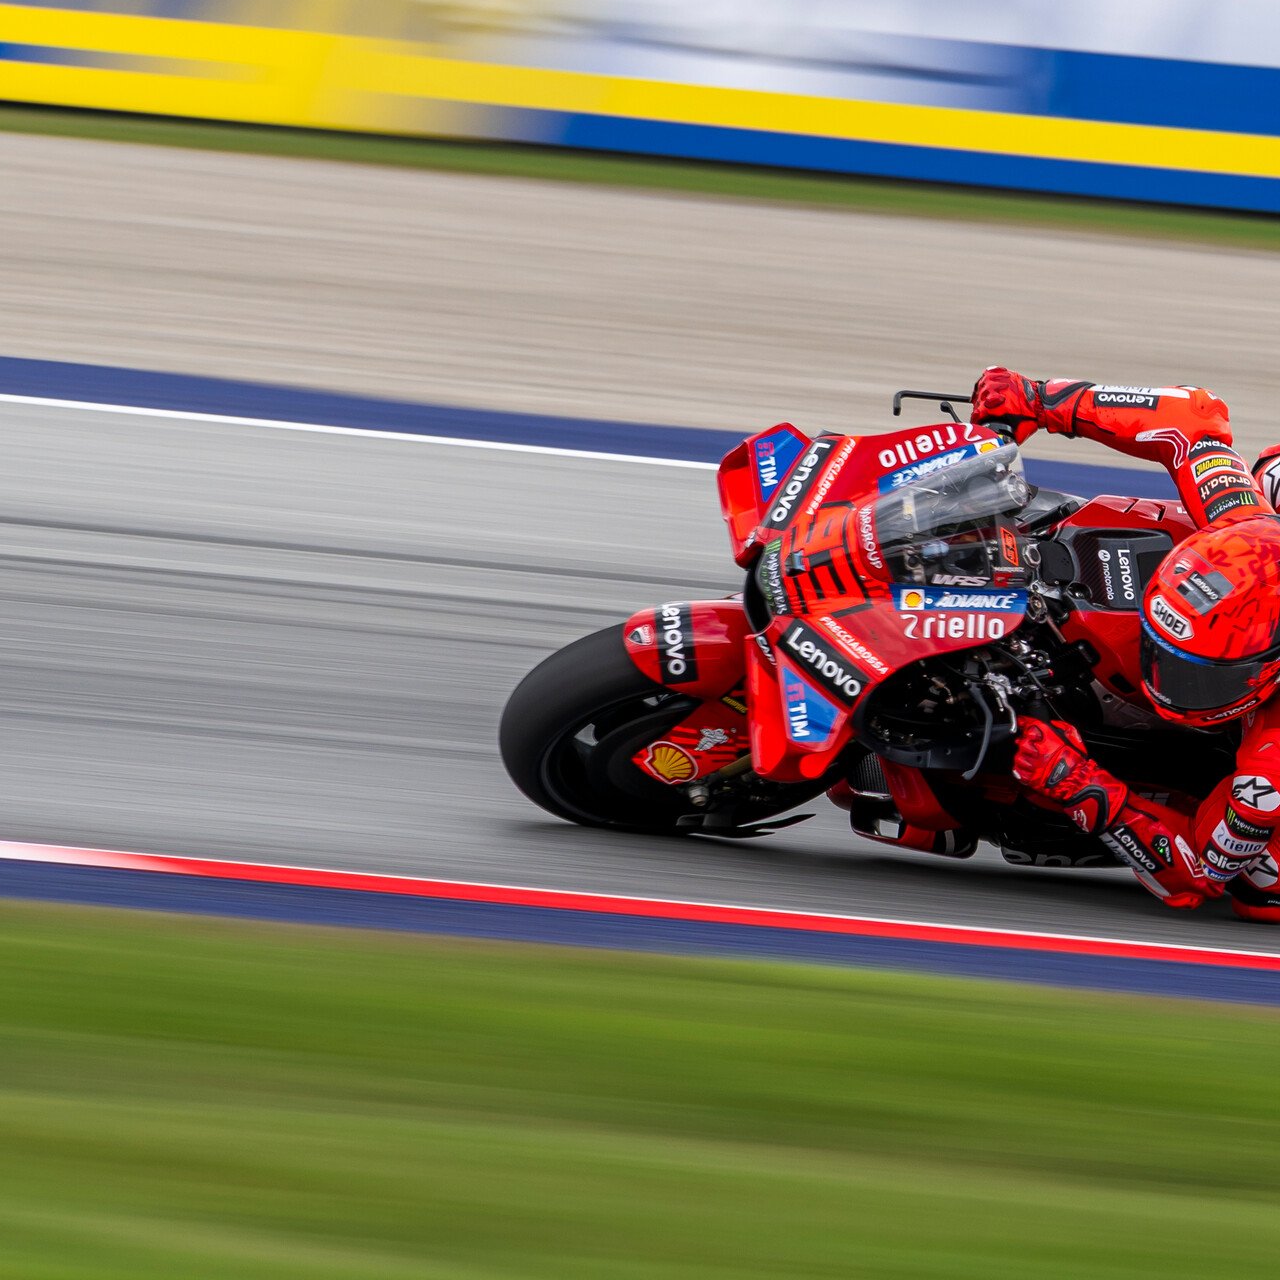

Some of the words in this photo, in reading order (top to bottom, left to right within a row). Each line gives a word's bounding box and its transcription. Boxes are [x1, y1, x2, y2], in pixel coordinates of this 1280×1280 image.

[1098, 393, 1154, 406] Lenovo
[879, 426, 957, 467] riello
[759, 457, 778, 487] TIM
[771, 442, 830, 522] Lenovo
[805, 438, 856, 515] FRECCIAROSSA
[931, 573, 991, 587] WRS
[1103, 563, 1114, 600] motorola
[1118, 549, 1135, 600] Lenovo
[1191, 573, 1218, 600] Lenovo
[935, 594, 1014, 609] ADVANCE
[1153, 601, 1186, 634] SHOEI
[923, 614, 1004, 639] riello
[786, 627, 861, 697] Lenovo
[819, 616, 889, 675] FRECCIAROSSA
[788, 703, 810, 738] TIM
[1206, 700, 1257, 720] Lenovo
[1114, 827, 1156, 870] Lenovo
[1224, 837, 1262, 853] riello
